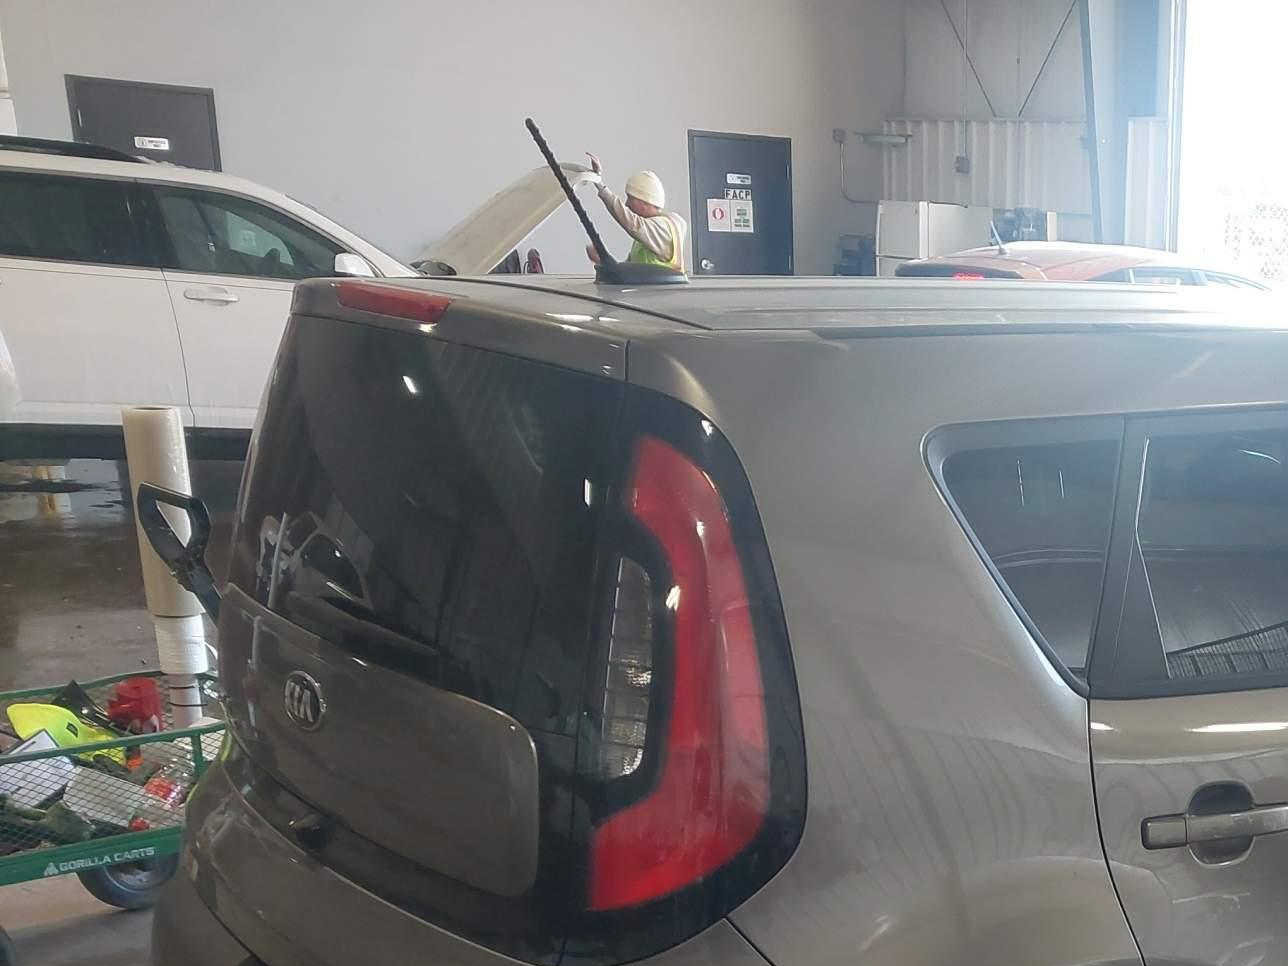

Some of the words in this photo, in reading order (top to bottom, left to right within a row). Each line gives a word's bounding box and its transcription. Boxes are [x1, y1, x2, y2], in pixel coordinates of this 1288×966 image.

[725, 189, 751, 200] FACP
[285, 679, 314, 723] KIA
[59, 855, 112, 872] GORILLA
[114, 846, 155, 862] CARTS
